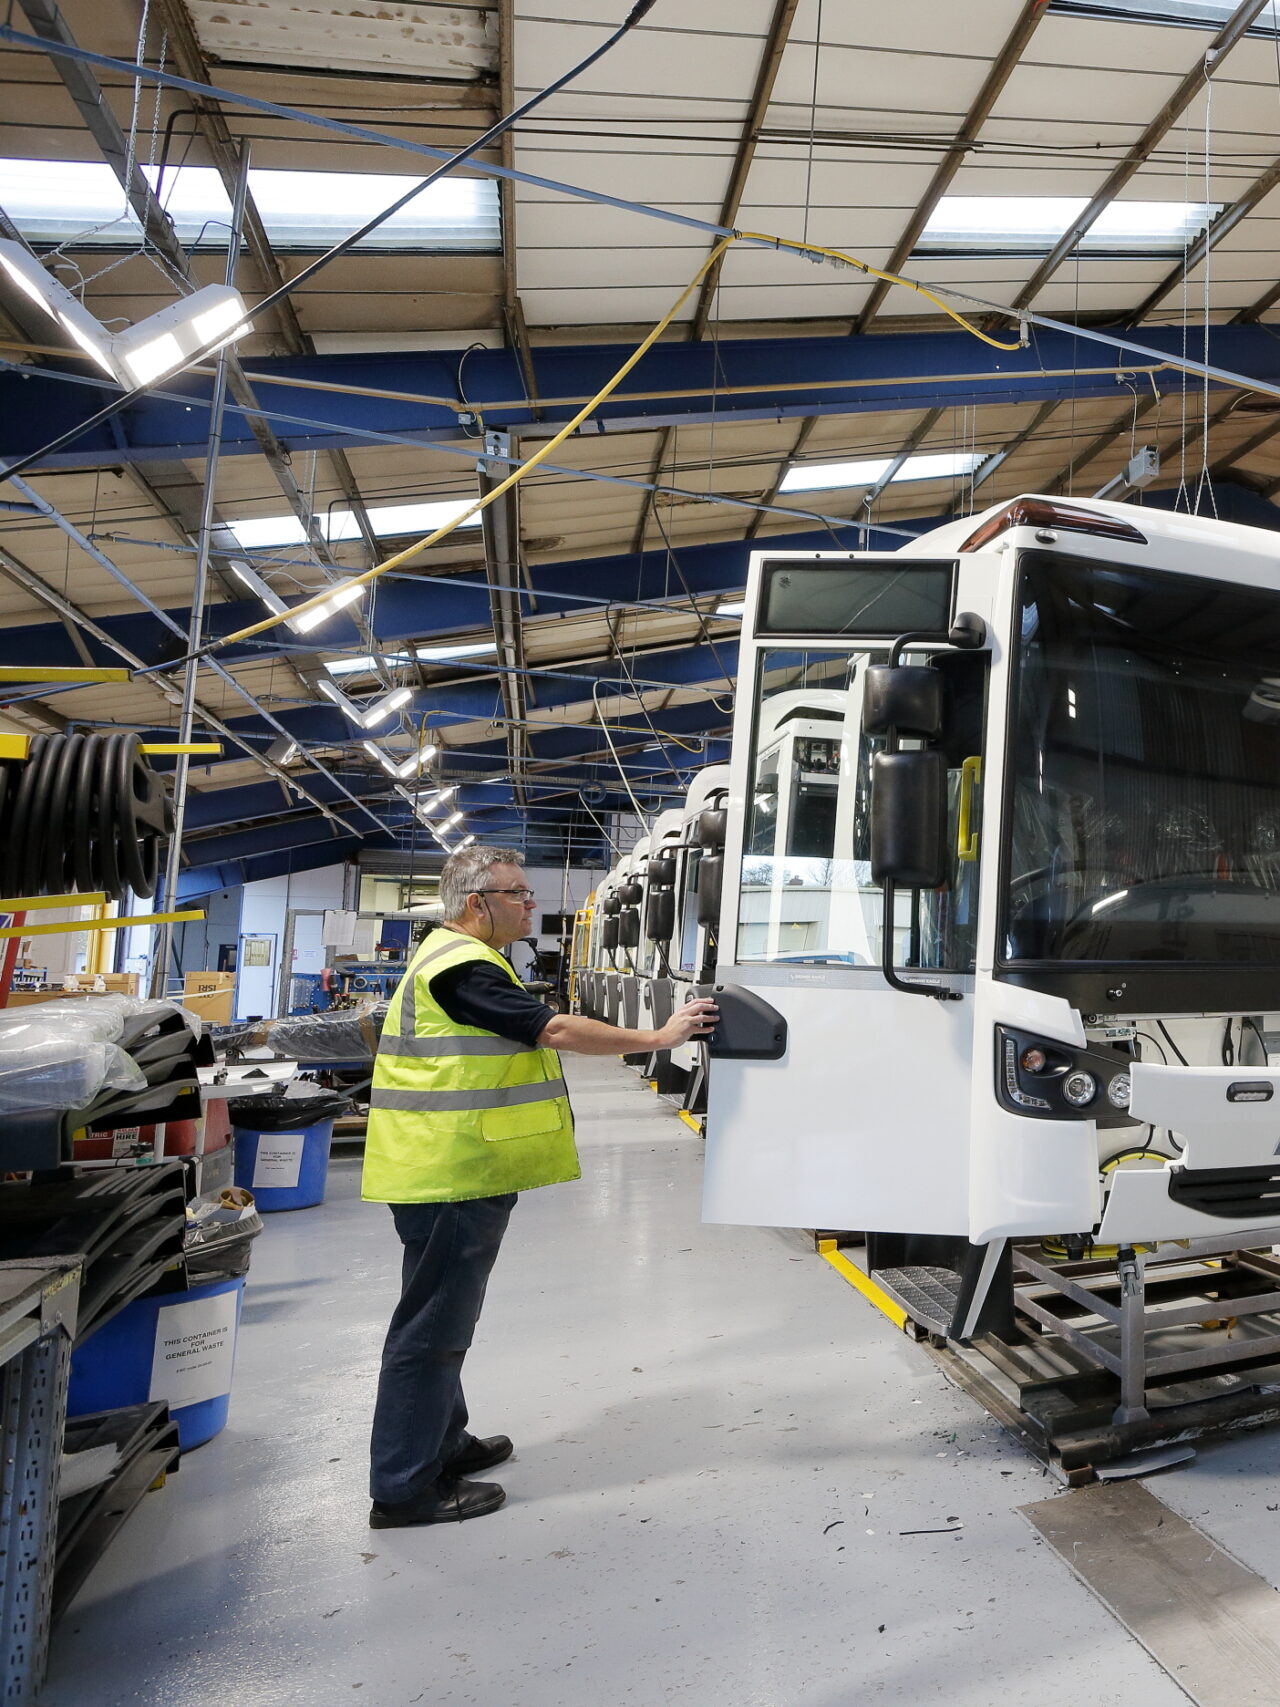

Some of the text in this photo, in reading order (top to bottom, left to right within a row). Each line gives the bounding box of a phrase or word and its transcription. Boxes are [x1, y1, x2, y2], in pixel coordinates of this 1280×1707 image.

[115, 1132, 138, 1141] HIRE
[164, 1338, 181, 1347] THIS
[182, 1329, 222, 1343] CONTAINER
[190, 1340, 205, 1349] FOR
[165, 1341, 224, 1360] GENERAL WASTE
